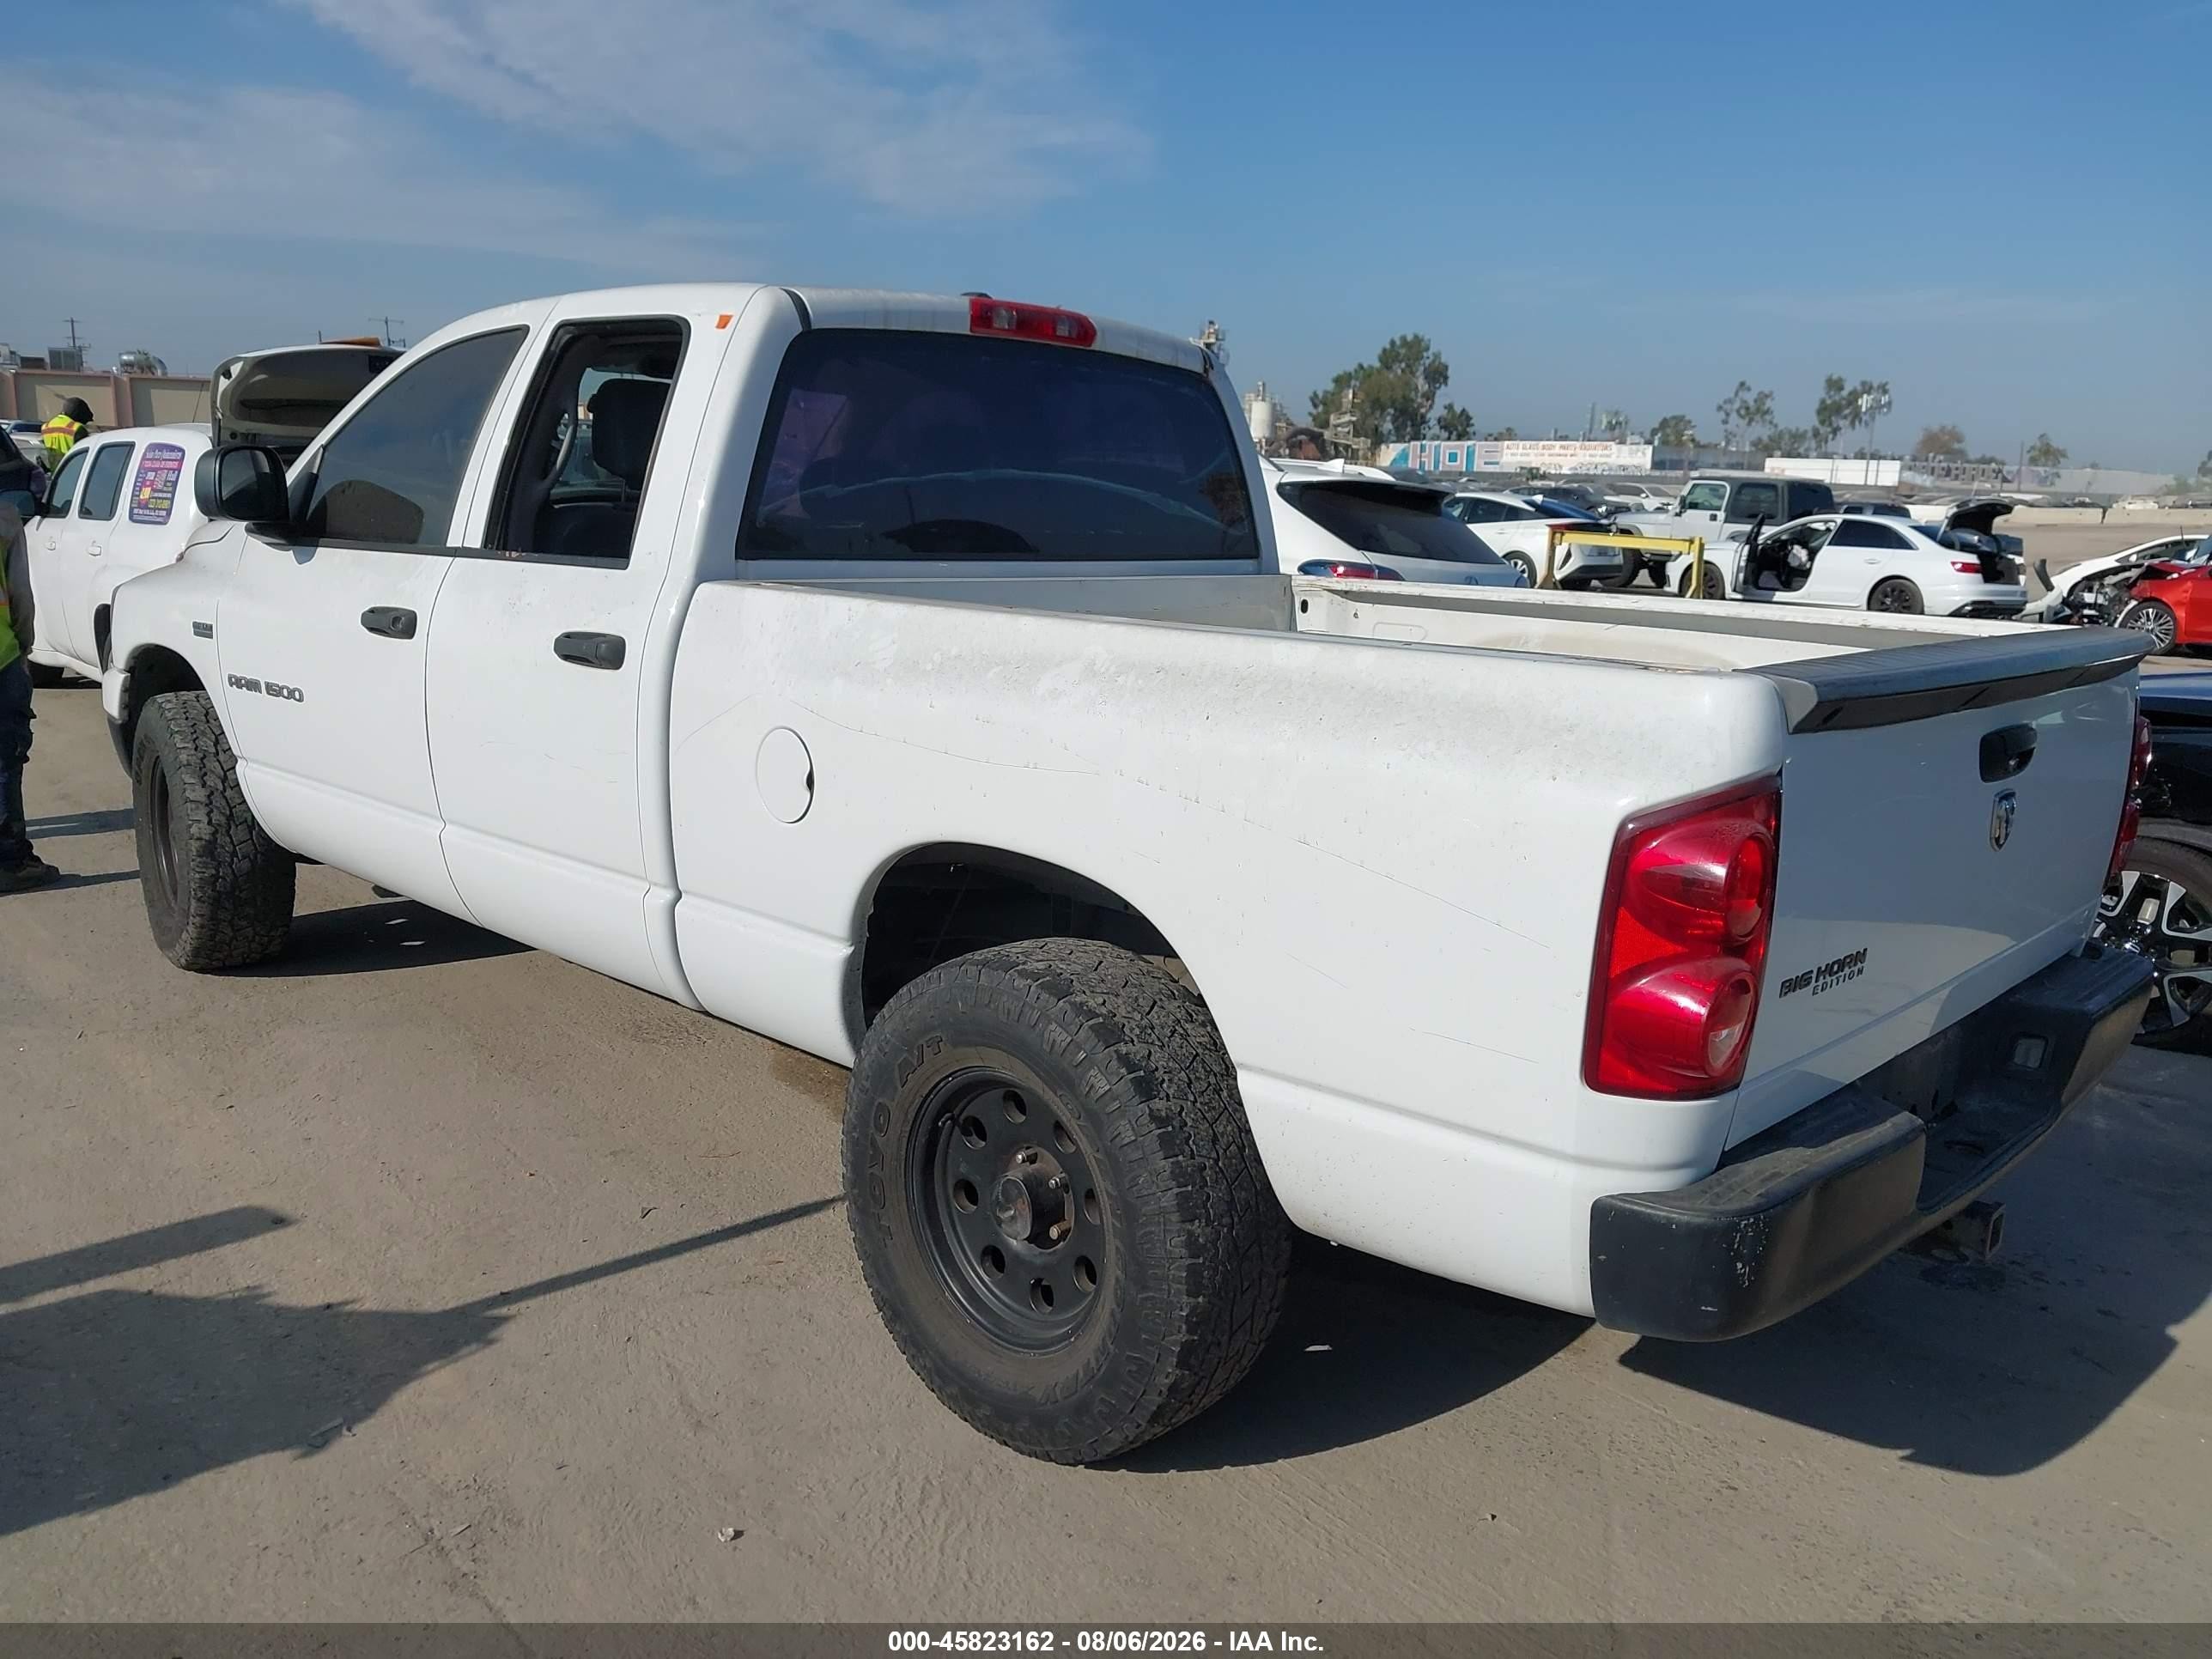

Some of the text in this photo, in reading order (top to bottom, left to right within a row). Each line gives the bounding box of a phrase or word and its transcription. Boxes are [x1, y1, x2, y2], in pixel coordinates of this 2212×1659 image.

[228, 673, 304, 703] RAM 1500
[1778, 947, 1868, 999] BIG HORN
[1812, 965, 1864, 997] EDITION
[867, 1100, 893, 1244] TOYO
